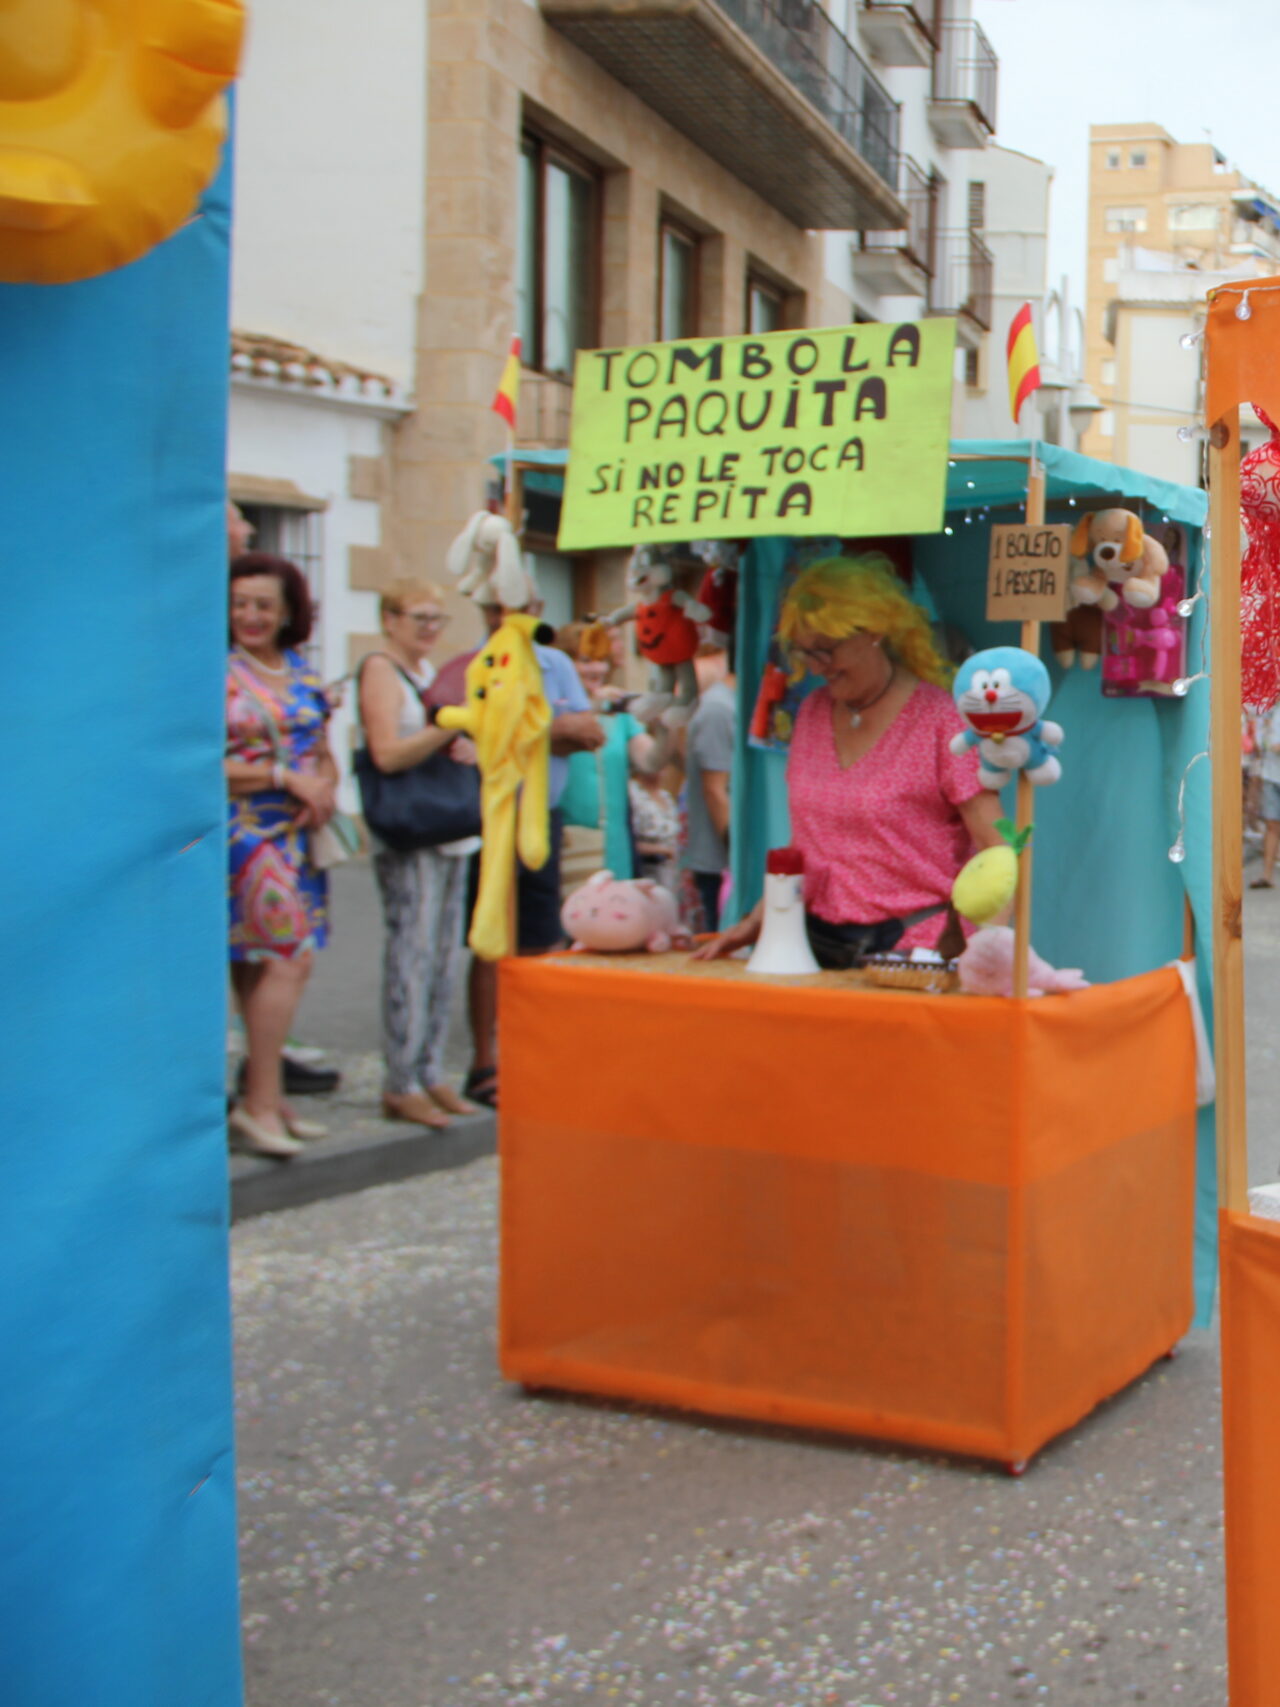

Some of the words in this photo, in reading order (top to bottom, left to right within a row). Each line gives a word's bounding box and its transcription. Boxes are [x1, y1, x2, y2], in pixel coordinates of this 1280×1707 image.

[595, 323, 920, 391] TOMBOLA
[638, 462, 684, 491] NO
[698, 453, 740, 483] LE
[760, 436, 865, 476] TOCA
[1007, 531, 1061, 558] BOLETO
[1005, 569, 1055, 595] PESETA
